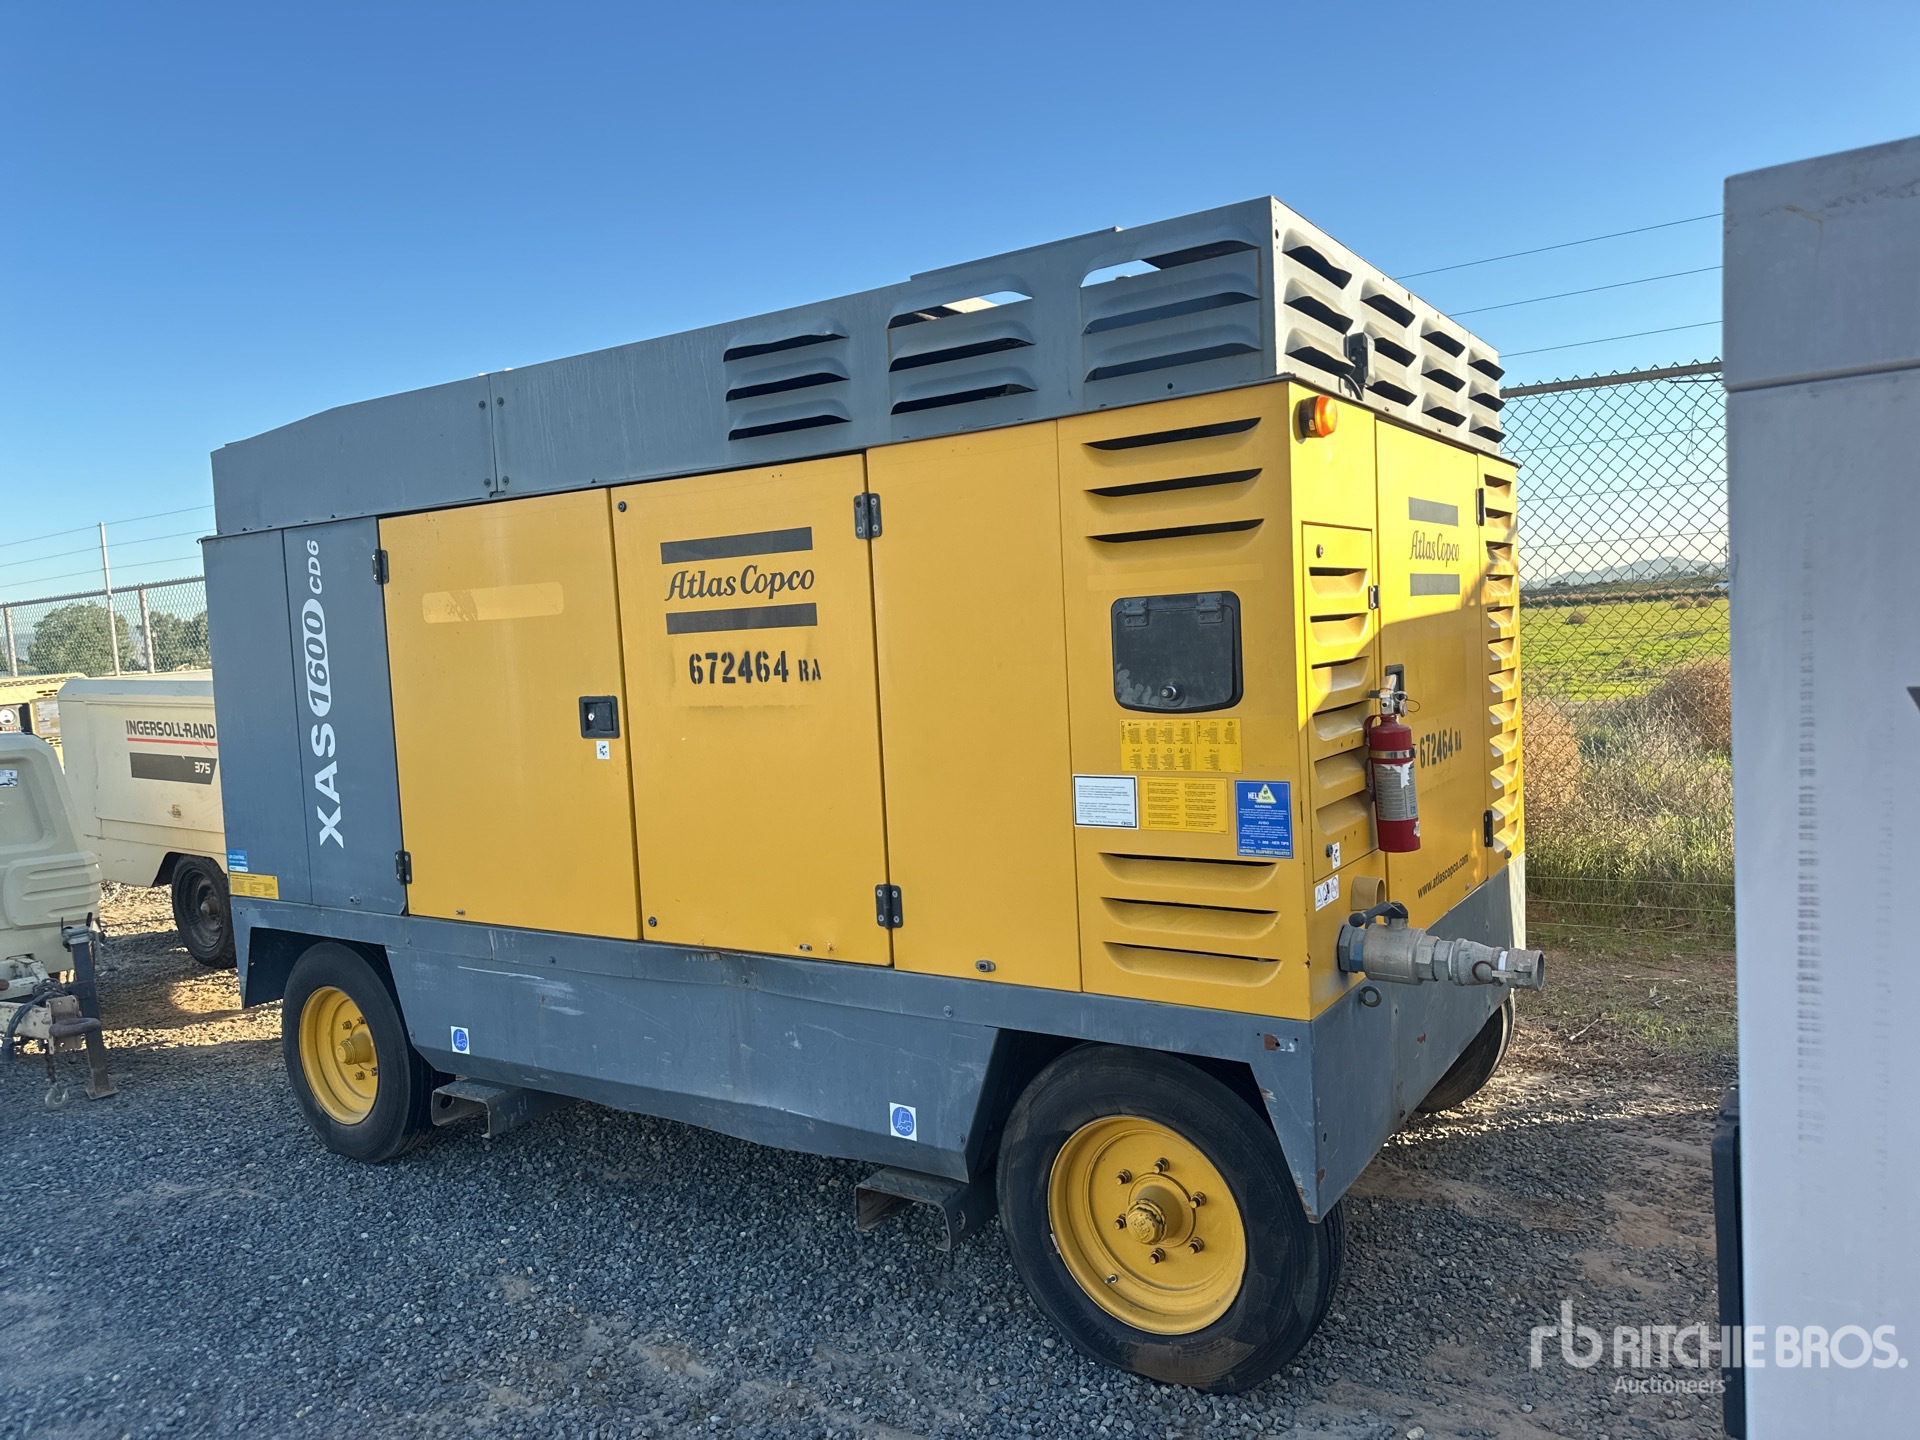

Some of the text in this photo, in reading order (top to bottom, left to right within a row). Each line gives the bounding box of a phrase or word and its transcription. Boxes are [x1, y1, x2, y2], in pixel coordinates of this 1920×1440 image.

[1409, 530, 1459, 567] Atlas Copco
[664, 564, 814, 601] Atlas Copco
[689, 651, 822, 685] 672464 RA
[303, 540, 344, 849] XAS 1600 CD6
[126, 719, 216, 740] INGERSOLL-RAND
[1420, 727, 1453, 769] 672464
[194, 761, 211, 774] 375
[1417, 853, 1469, 899] www.atlascopco.com
